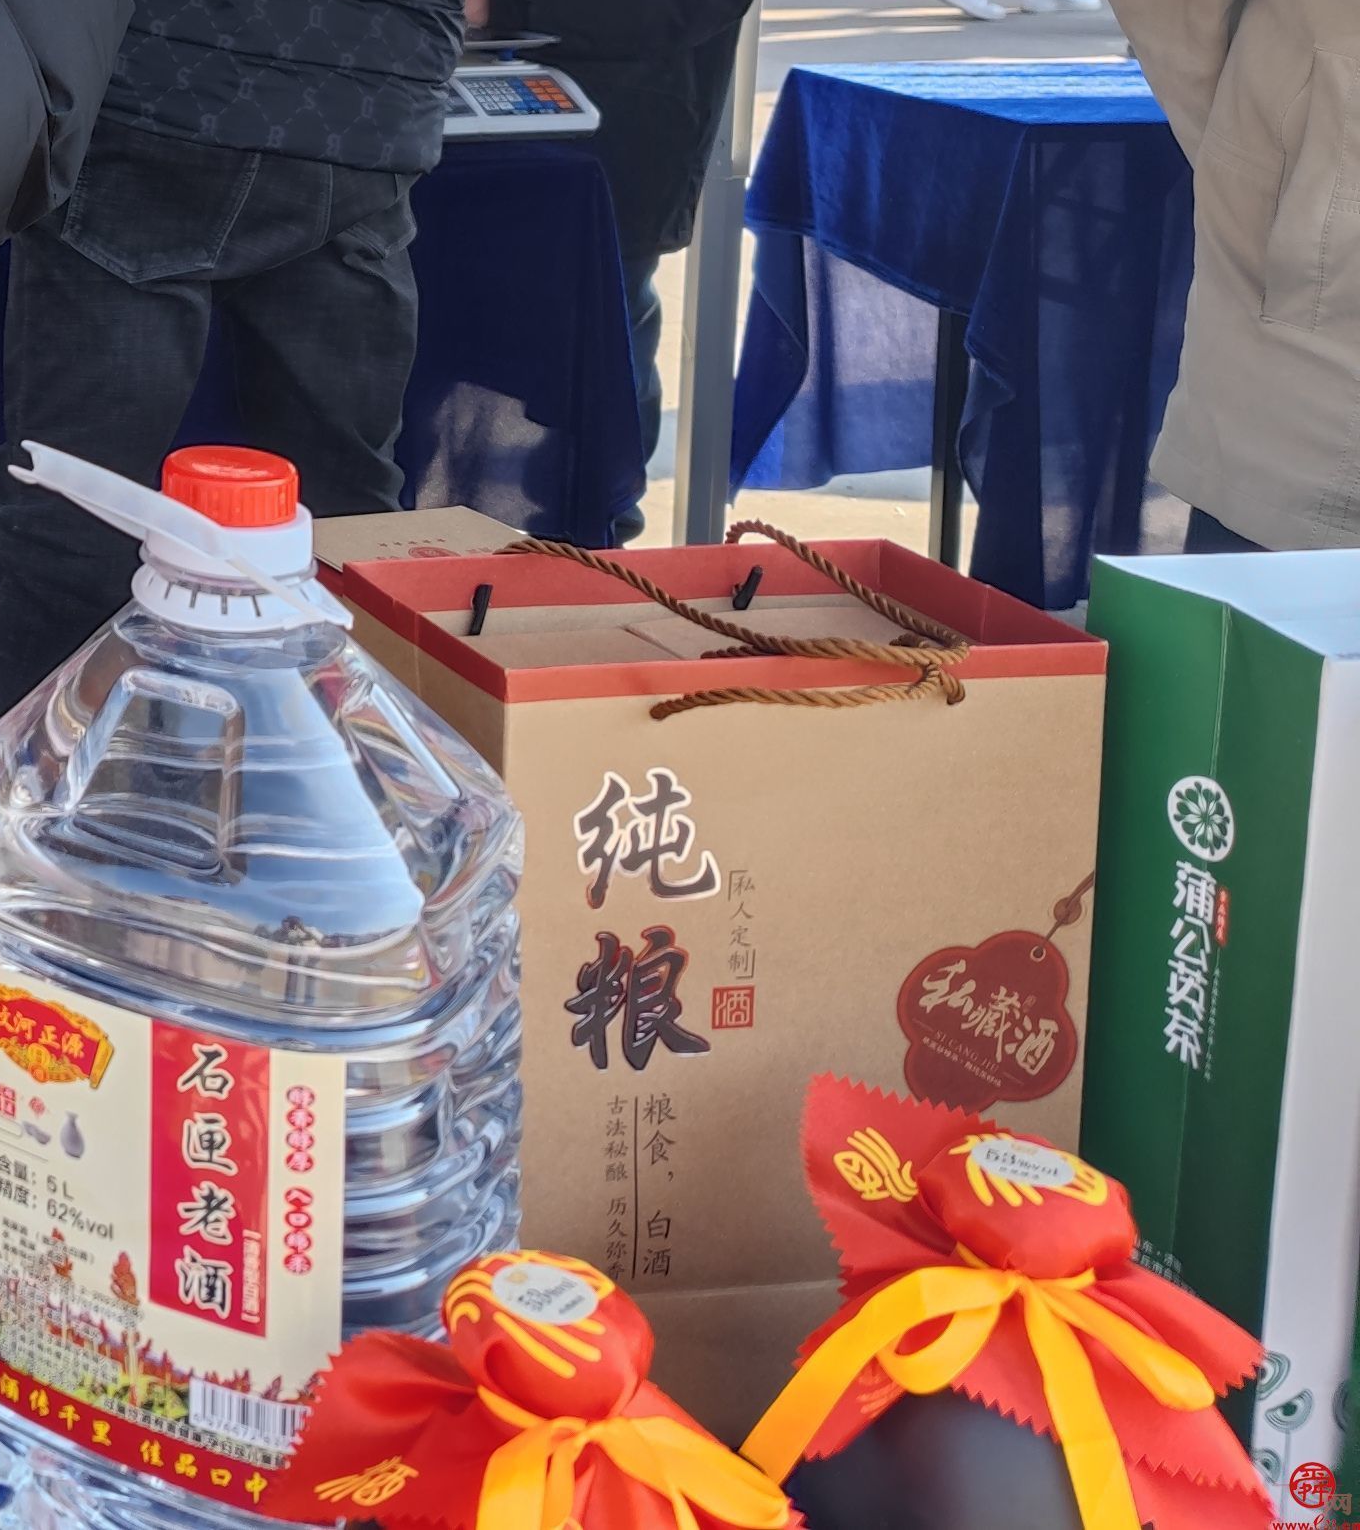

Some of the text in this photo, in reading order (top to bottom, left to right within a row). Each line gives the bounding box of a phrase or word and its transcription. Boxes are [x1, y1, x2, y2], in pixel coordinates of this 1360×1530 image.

[564, 766, 722, 1072] 纯粮
[918, 958, 1060, 1077] 私藏酒
[1164, 859, 1216, 1070] 蒲公英茶
[175, 1042, 238, 1318] 石匣老酒
